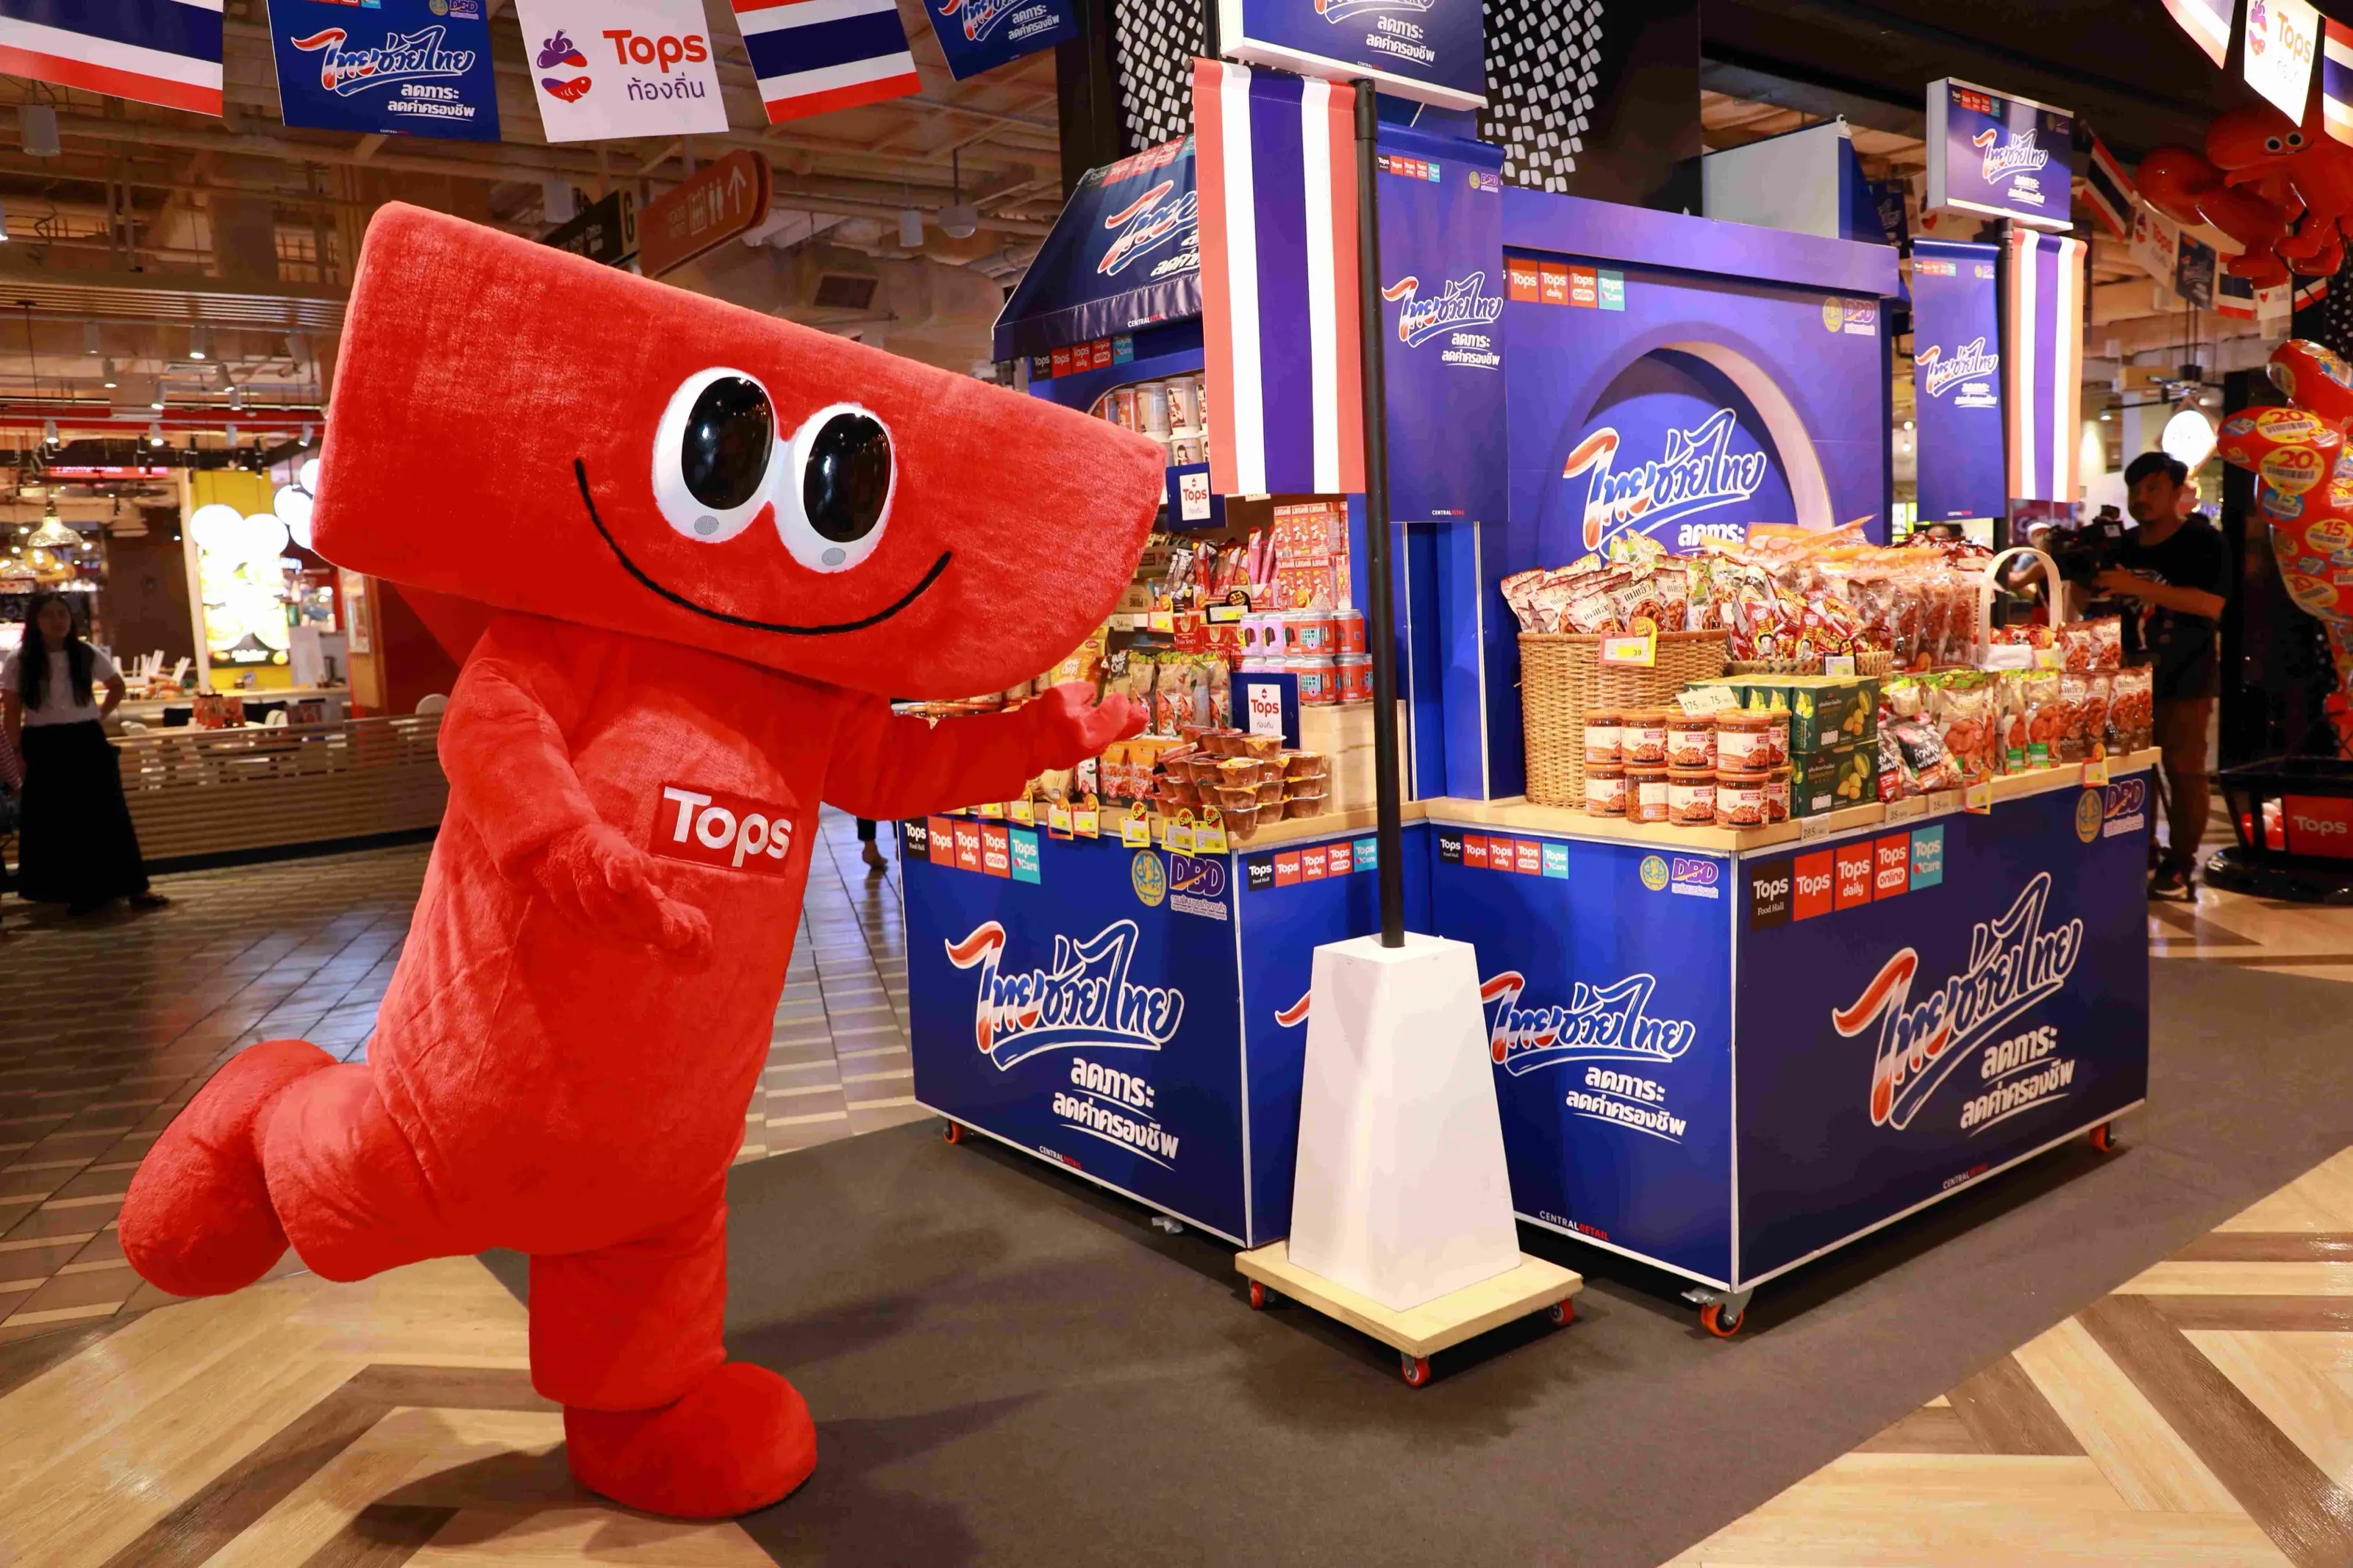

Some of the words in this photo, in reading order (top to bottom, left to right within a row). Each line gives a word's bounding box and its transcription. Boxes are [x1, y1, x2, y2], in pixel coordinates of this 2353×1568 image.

[1011, 4, 1047, 24] ลดภาระ
[1007, 14, 1060, 40] ลดค่าครองชีพ
[1377, 15, 1424, 39] ลดภาระ
[2277, 11, 2313, 63] Tops
[602, 30, 707, 74] Tops
[1365, 32, 1435, 62] ลดค่าครองชีพ
[291, 24, 476, 90] ไทยช่วยไทย
[401, 84, 460, 100] ลดภาระ
[627, 71, 706, 101] ท้องถิ่น
[387, 100, 476, 117] ลดค่าครองชีพ
[1377, 157, 1390, 165] Tops
[1511, 272, 1538, 289] Tops
[1540, 272, 1567, 288] Tops
[1571, 273, 1595, 287] Tops
[1600, 277, 1622, 292] Tops
[1546, 288, 1563, 300] daily
[1382, 271, 1504, 342] ไทยช่วยไทย
[1094, 340, 1110, 351] Tops
[1451, 332, 1492, 348] ลดภาระ
[1052, 354, 1071, 366] Tops
[1074, 346, 1090, 358] Tops
[1441, 349, 1500, 366] ลดค่าครองชีพ
[1033, 355, 1051, 368] Tops
[1914, 336, 1999, 394] ไทยช่วยไทย
[2269, 411, 2304, 423] 20
[2277, 449, 2315, 469] 20
[1563, 407, 1767, 552] ไทยช่วยไทย
[1182, 488, 1207, 504] Tops
[2323, 521, 2346, 537] 15
[1251, 698, 1279, 717] Tops
[1684, 700, 1699, 712] 175
[1710, 695, 1721, 705] 75
[1132, 806, 1146, 818] Sale
[1206, 812, 1220, 823] Sale
[663, 786, 792, 868] Tops
[1179, 816, 1194, 826] Sale
[2293, 815, 2348, 837] Tops
[904, 823, 926, 842] Tops
[929, 831, 953, 851] Tops
[956, 831, 979, 851] Tops
[983, 832, 1007, 851] Tops
[1012, 838, 1037, 858] Tops
[1440, 839, 1461, 852] Tops
[1914, 840, 1941, 859] Tops
[960, 851, 976, 864] daily
[1329, 848, 1350, 859] Tops
[1356, 845, 1375, 856] Tops
[1464, 844, 1487, 857] Tops
[1490, 845, 1513, 858] Tops
[1518, 845, 1539, 859] Tops
[1545, 849, 1566, 863] Tops
[1878, 846, 1907, 867] Tops
[986, 853, 1007, 866] online
[1021, 860, 1038, 872] Care
[1303, 854, 1326, 867] Tops
[1332, 861, 1349, 869] online
[1494, 857, 1509, 866] daily
[1519, 859, 1538, 868] online
[1170, 853, 1226, 897] DBD
[1248, 864, 1273, 877] Tops
[1277, 862, 1299, 876] Tops
[1671, 857, 1719, 884] DBD
[1838, 859, 1871, 881] Tops
[1879, 870, 1904, 884] online
[1752, 878, 1789, 901] Tops
[1796, 873, 1831, 896] Tops
[1843, 882, 1864, 897] daily
[1757, 904, 1771, 916] Food
[1771, 901, 1785, 912] Hall
[945, 919, 1185, 1053] ไทยช่วยไทย
[1832, 871, 2084, 1127] ไทยช่วยไทย
[1480, 970, 1696, 1065] ไทยช่วยไทย
[1981, 1024, 2058, 1079] ลดภาระ
[1070, 1056, 1155, 1110] ลดภาระ
[1584, 1066, 1666, 1103] ลดภาระ
[1960, 1059, 2076, 1129] ลดค่าครองชีพ
[1565, 1089, 1688, 1136] ลดค่าครองชีพ
[1052, 1092, 1179, 1161] ลดค่าครองชีพ
